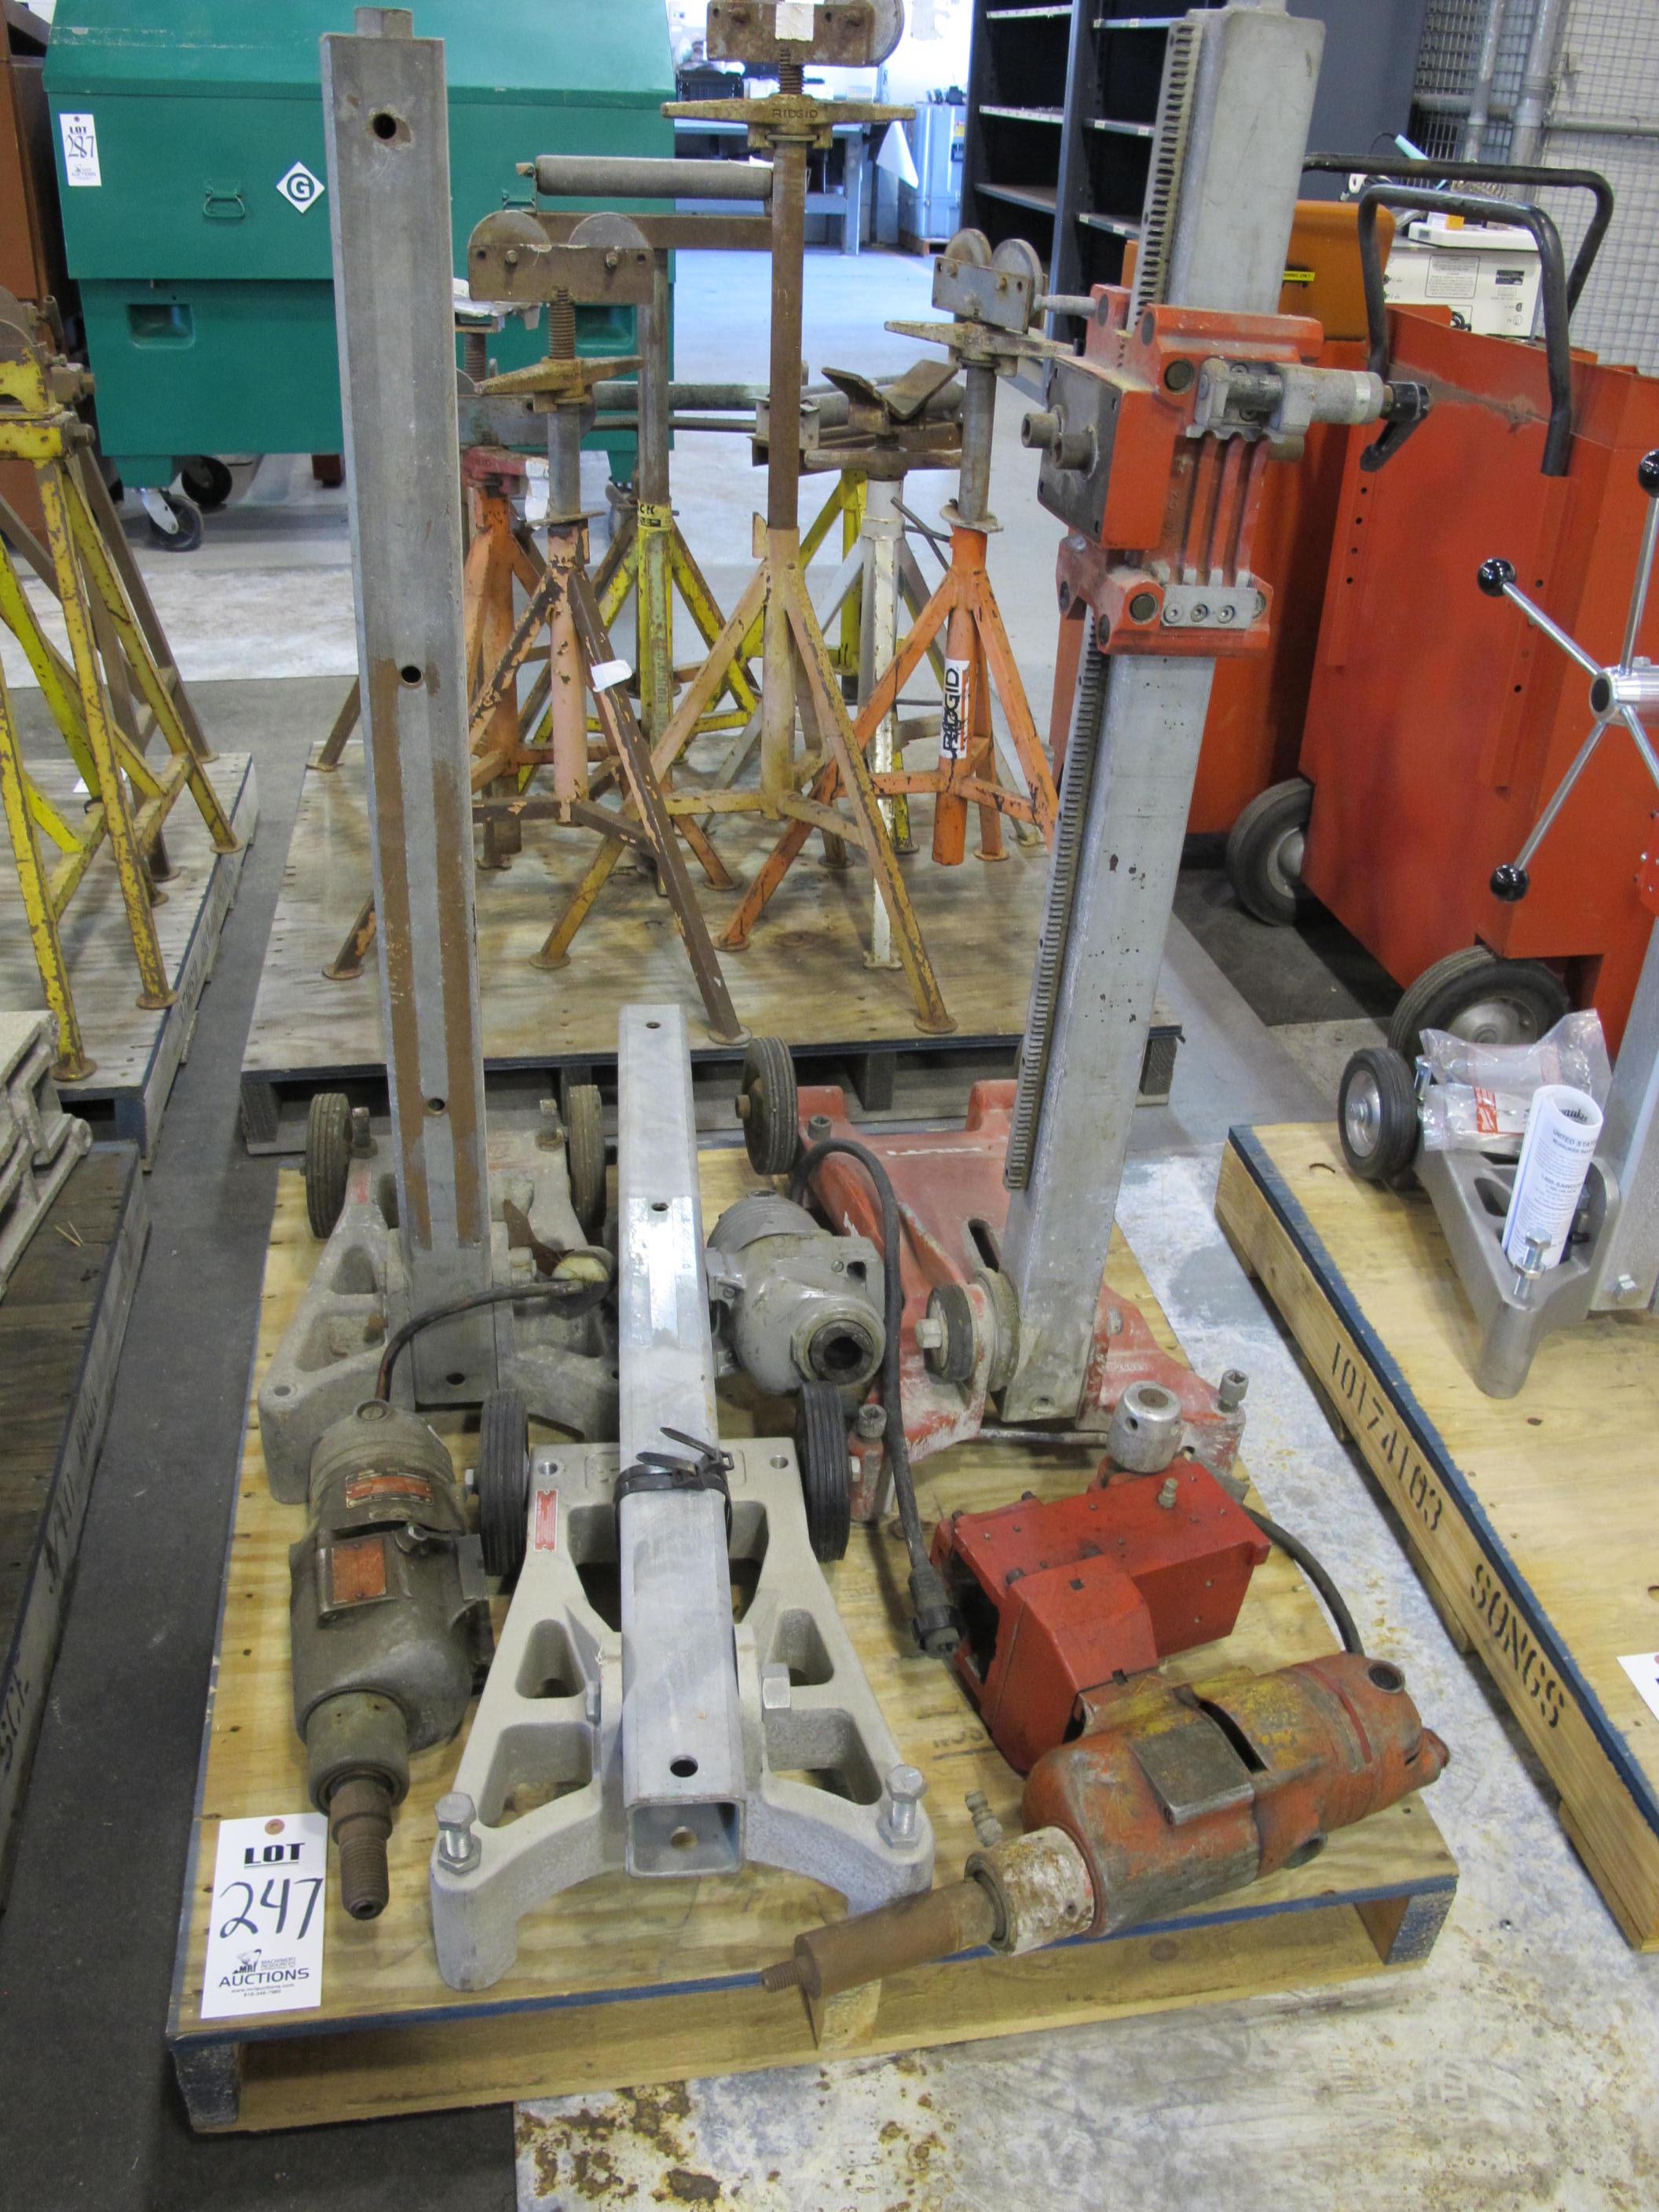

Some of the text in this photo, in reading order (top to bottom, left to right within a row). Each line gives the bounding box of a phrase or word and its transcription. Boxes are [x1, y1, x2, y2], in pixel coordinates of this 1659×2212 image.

[771, 108, 819, 119] RIDGID
[69, 126, 87, 134] LOT
[64, 134, 94, 158] 287
[290, 175, 310, 199] G
[1470, 1563, 1565, 1729] SONGS
[244, 1842, 306, 1865] LOT
[219, 1878, 324, 1940] 247
[218, 1968, 309, 1988] AUCTIONS
